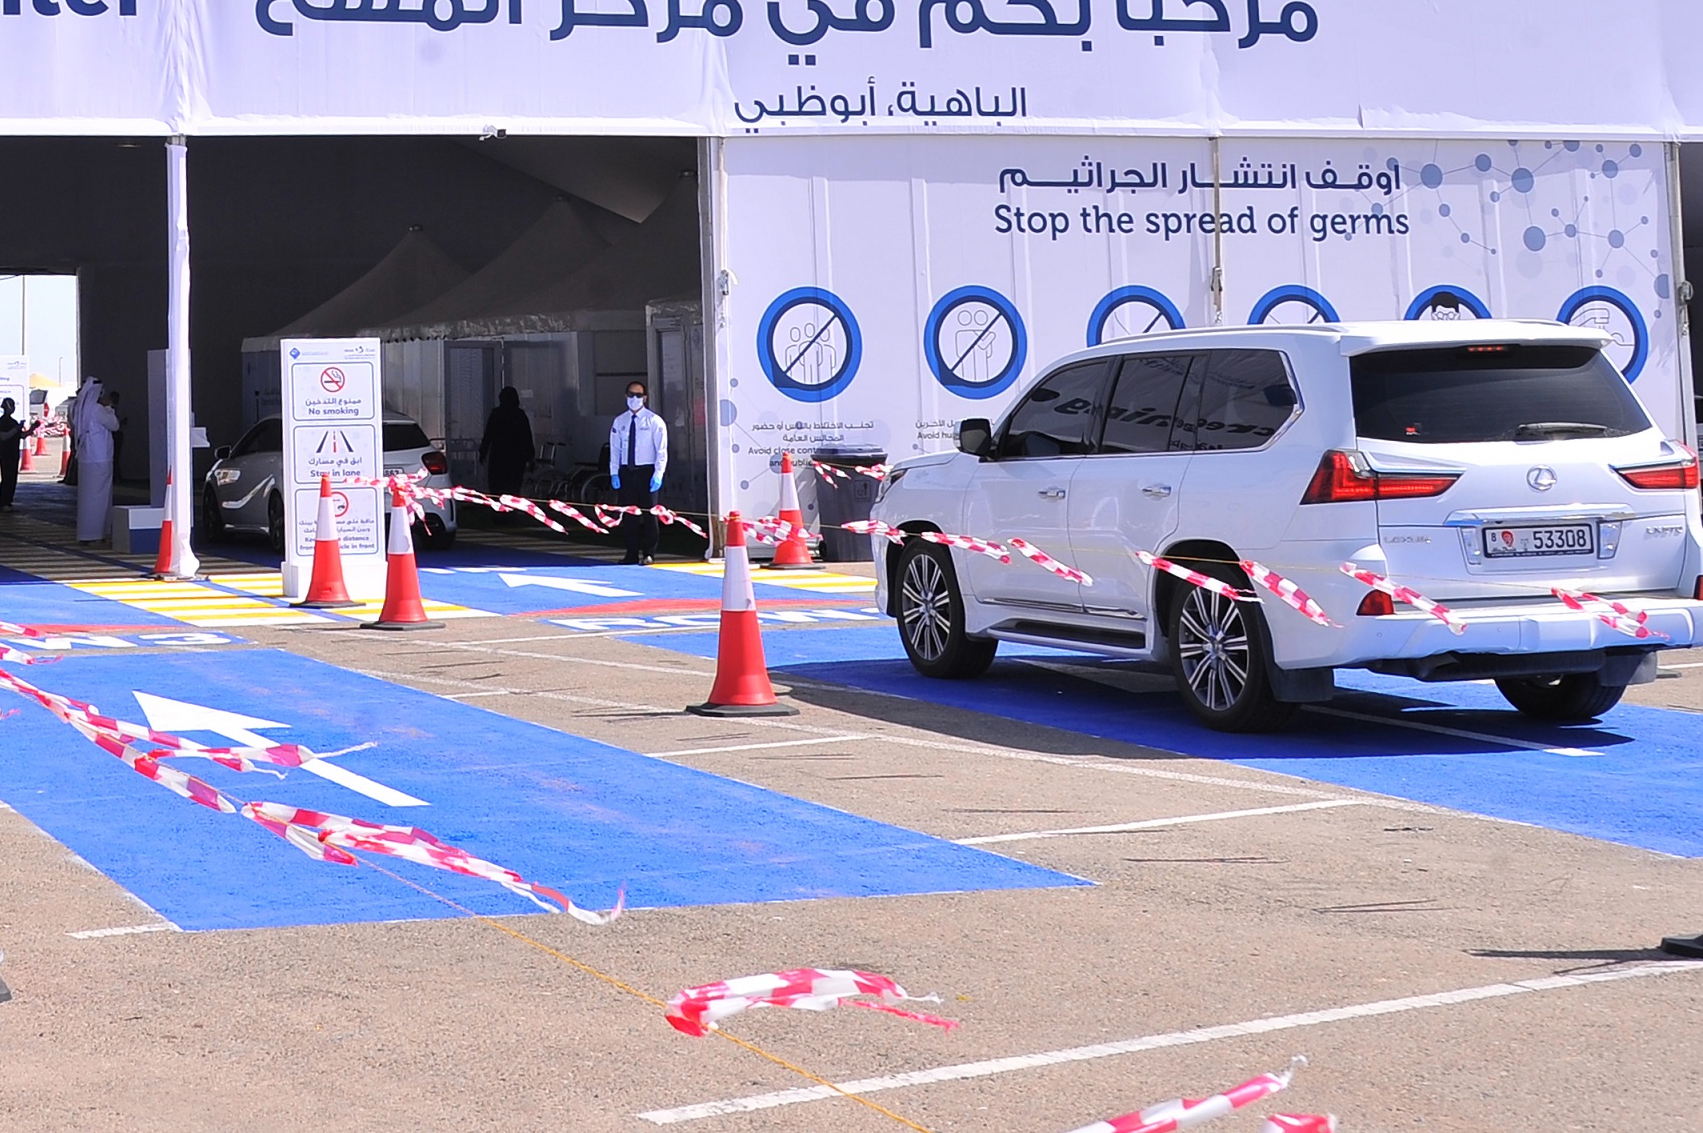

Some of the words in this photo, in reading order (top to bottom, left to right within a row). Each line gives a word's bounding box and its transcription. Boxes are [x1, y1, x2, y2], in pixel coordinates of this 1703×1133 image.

[733, 76, 877, 133] أبوظبي
[999, 155, 1168, 194] الجراثيم
[1178, 157, 1296, 194] انتشار
[994, 204, 1070, 240] Stop
[1080, 206, 1134, 234] the
[1146, 206, 1257, 241] spread
[1267, 206, 1299, 234] of
[1310, 211, 1410, 242] germs
[323, 407, 359, 416] smoking
[748, 447, 772, 455] Avoid
[1533, 529, 1586, 549] 53308
